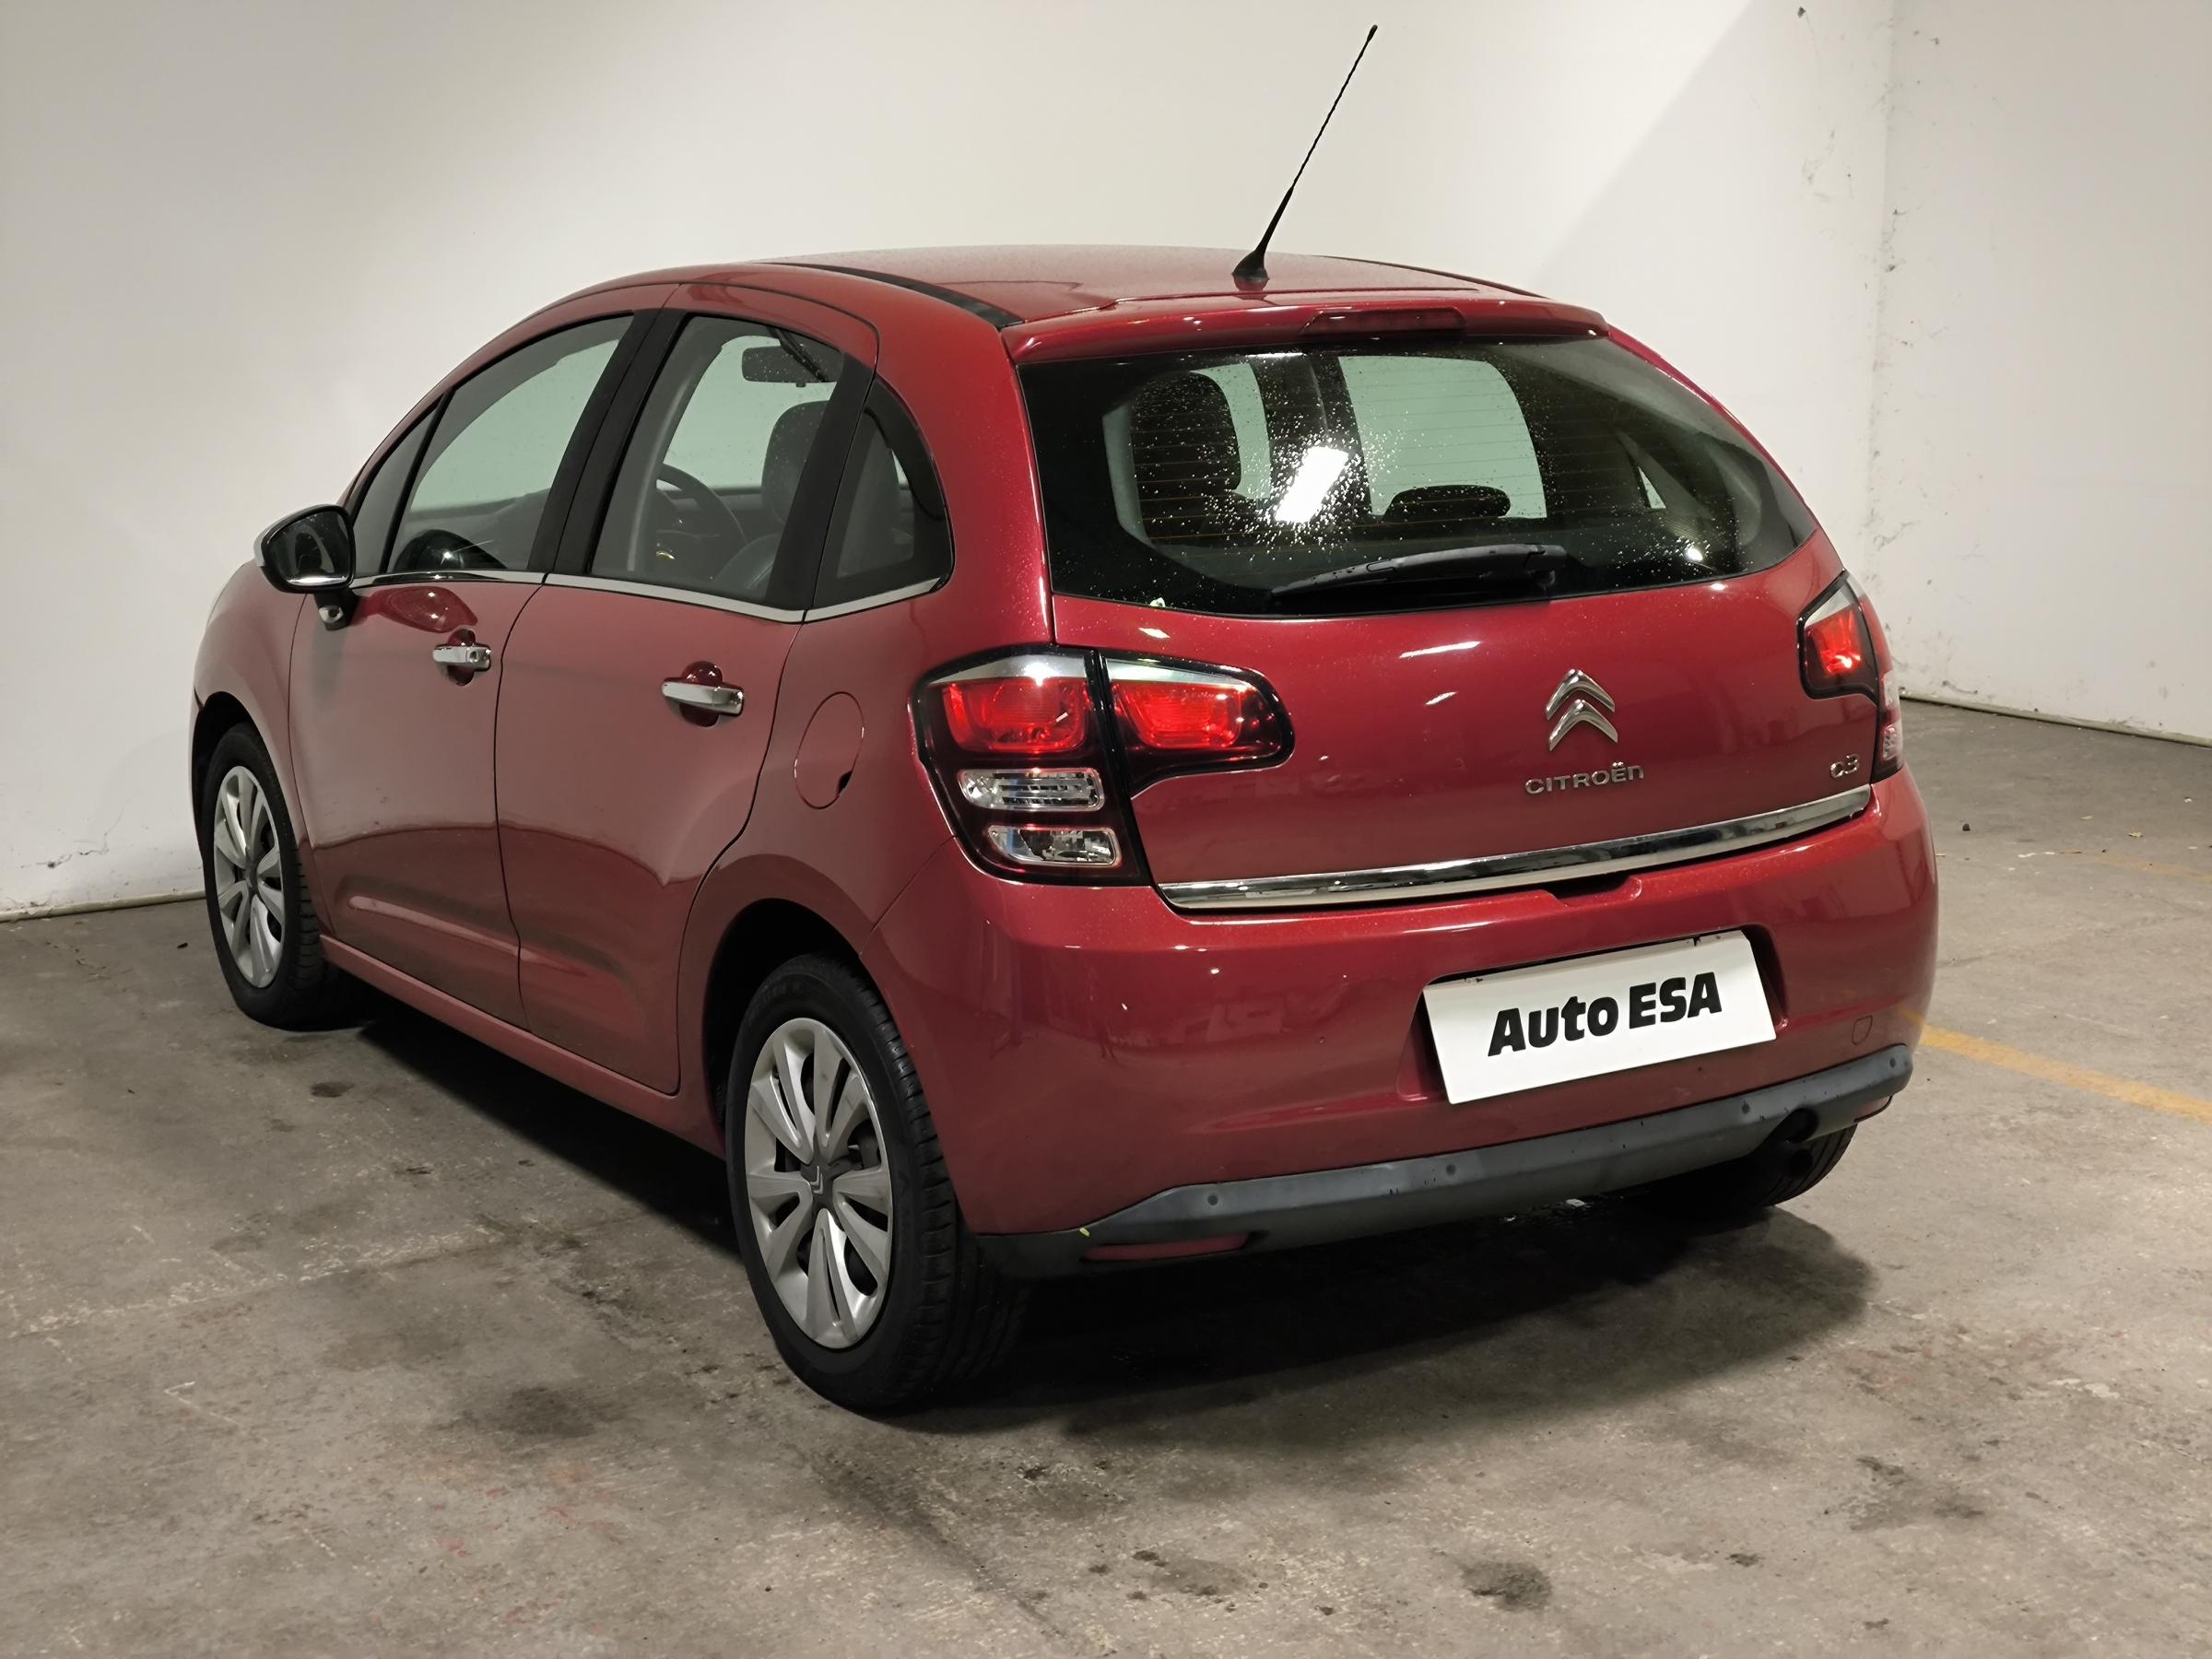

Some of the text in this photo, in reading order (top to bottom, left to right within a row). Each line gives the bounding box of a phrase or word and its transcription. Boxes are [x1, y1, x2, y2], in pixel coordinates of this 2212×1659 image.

[1830, 753, 1860, 779] C3
[1488, 971, 1723, 1057] Auto ESA
